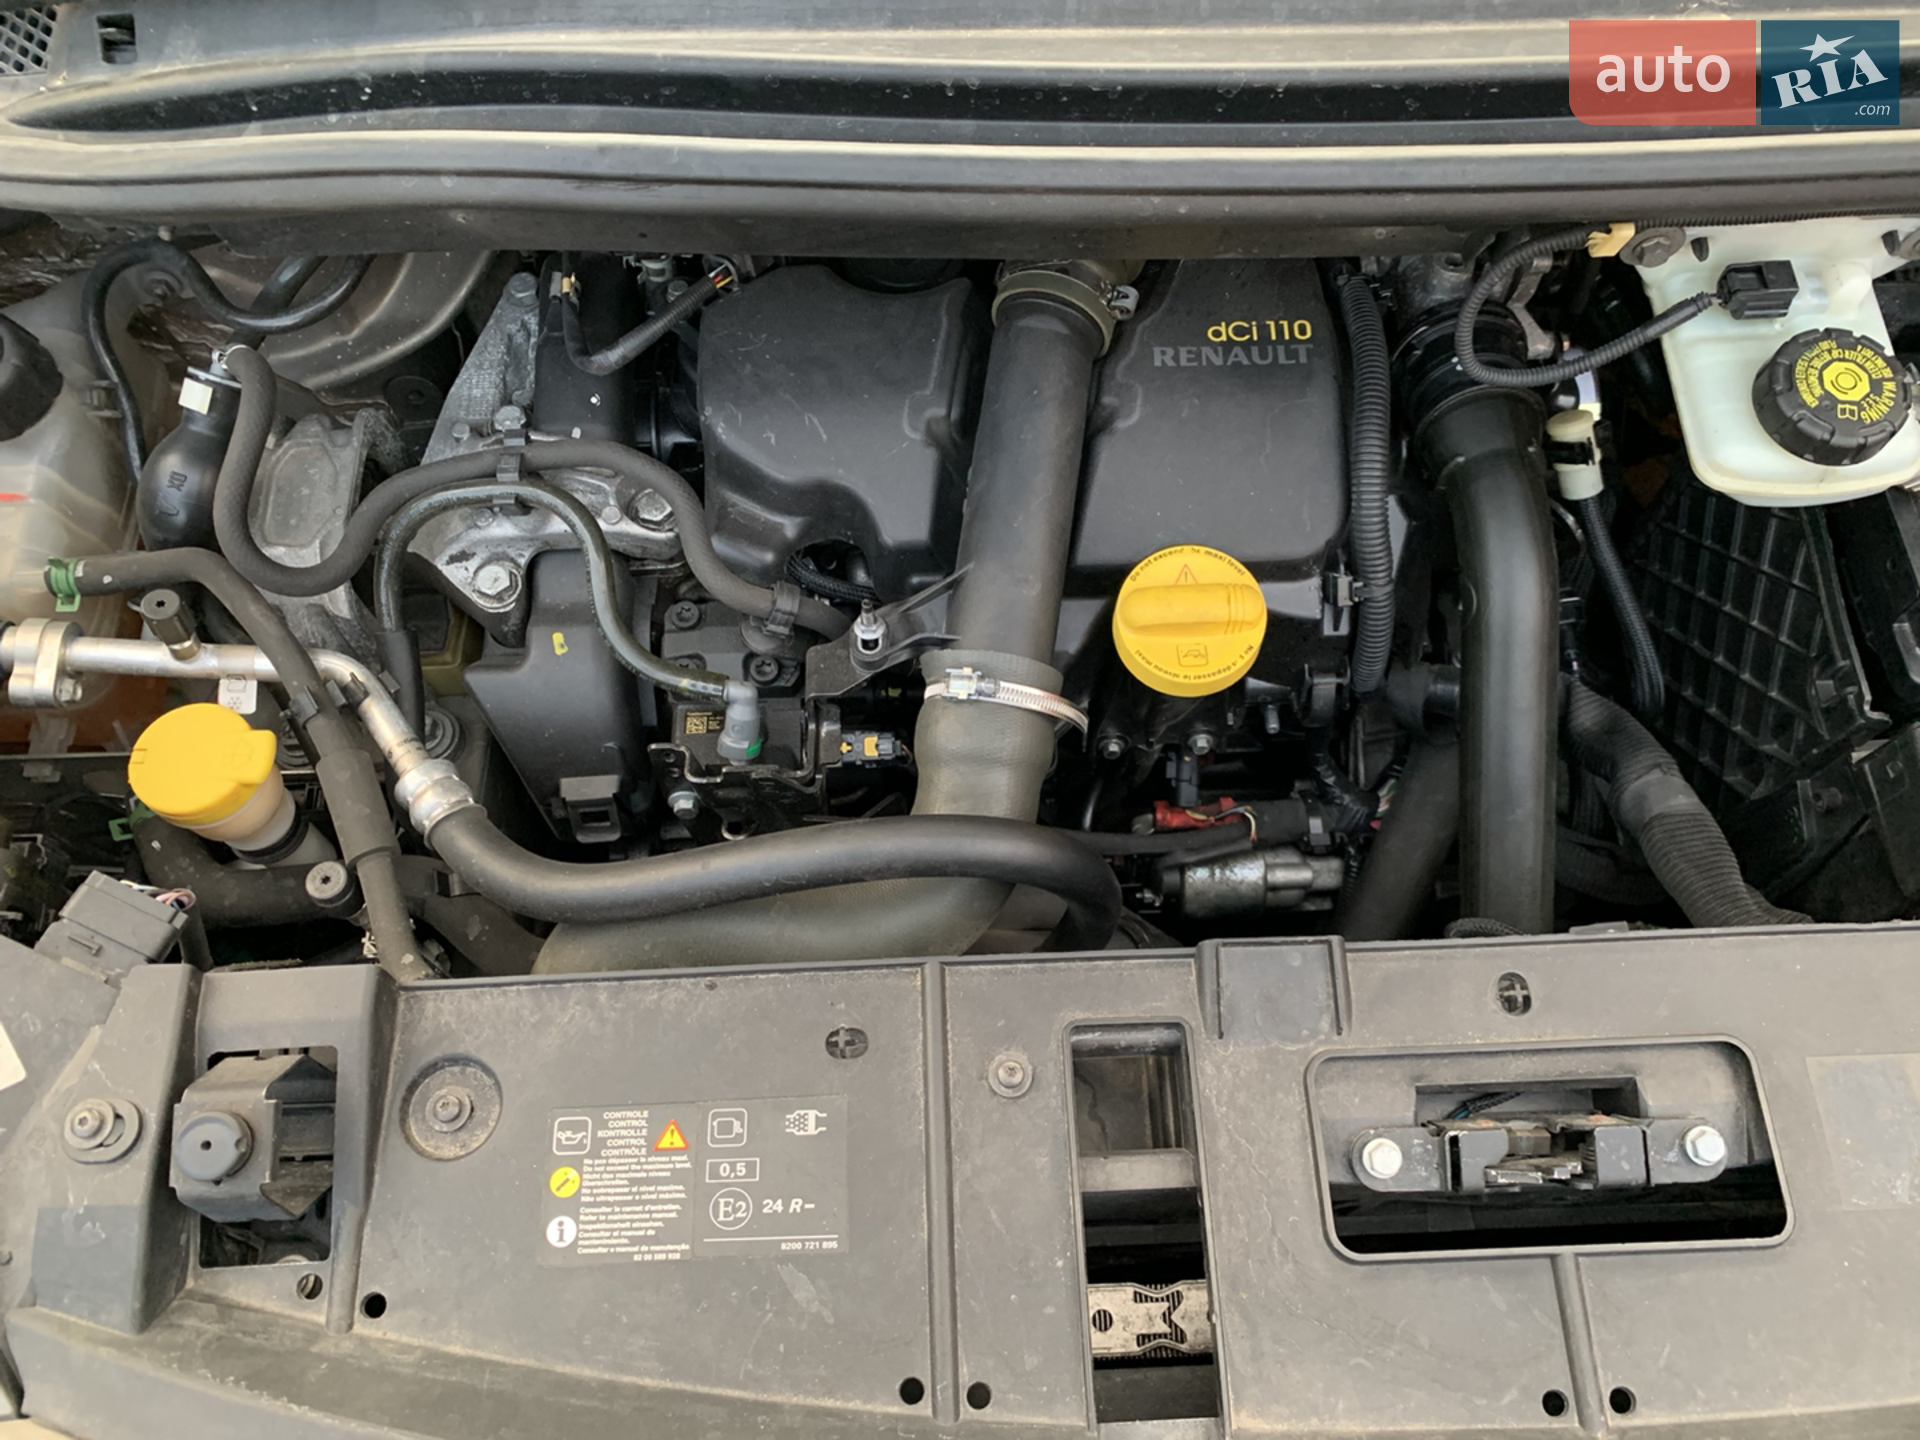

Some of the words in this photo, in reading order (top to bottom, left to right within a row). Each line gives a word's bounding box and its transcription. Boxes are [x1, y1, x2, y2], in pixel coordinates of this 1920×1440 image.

[1207, 320, 1258, 342] dCi
[1266, 319, 1312, 341] 110
[1152, 344, 1314, 367] RENAULT
[1860, 381, 1898, 424] WARNING
[603, 1110, 649, 1119] CONTROLE
[608, 1119, 649, 1128] CONTROL
[597, 1128, 648, 1138] KONTROLLE
[606, 1137, 647, 1147] CONTROL
[719, 1162, 747, 1179] 0,5
[717, 1198, 748, 1221] E2
[762, 1198, 784, 1214] 24
[780, 1242, 802, 1250] 8200
[804, 1241, 820, 1249] 721
